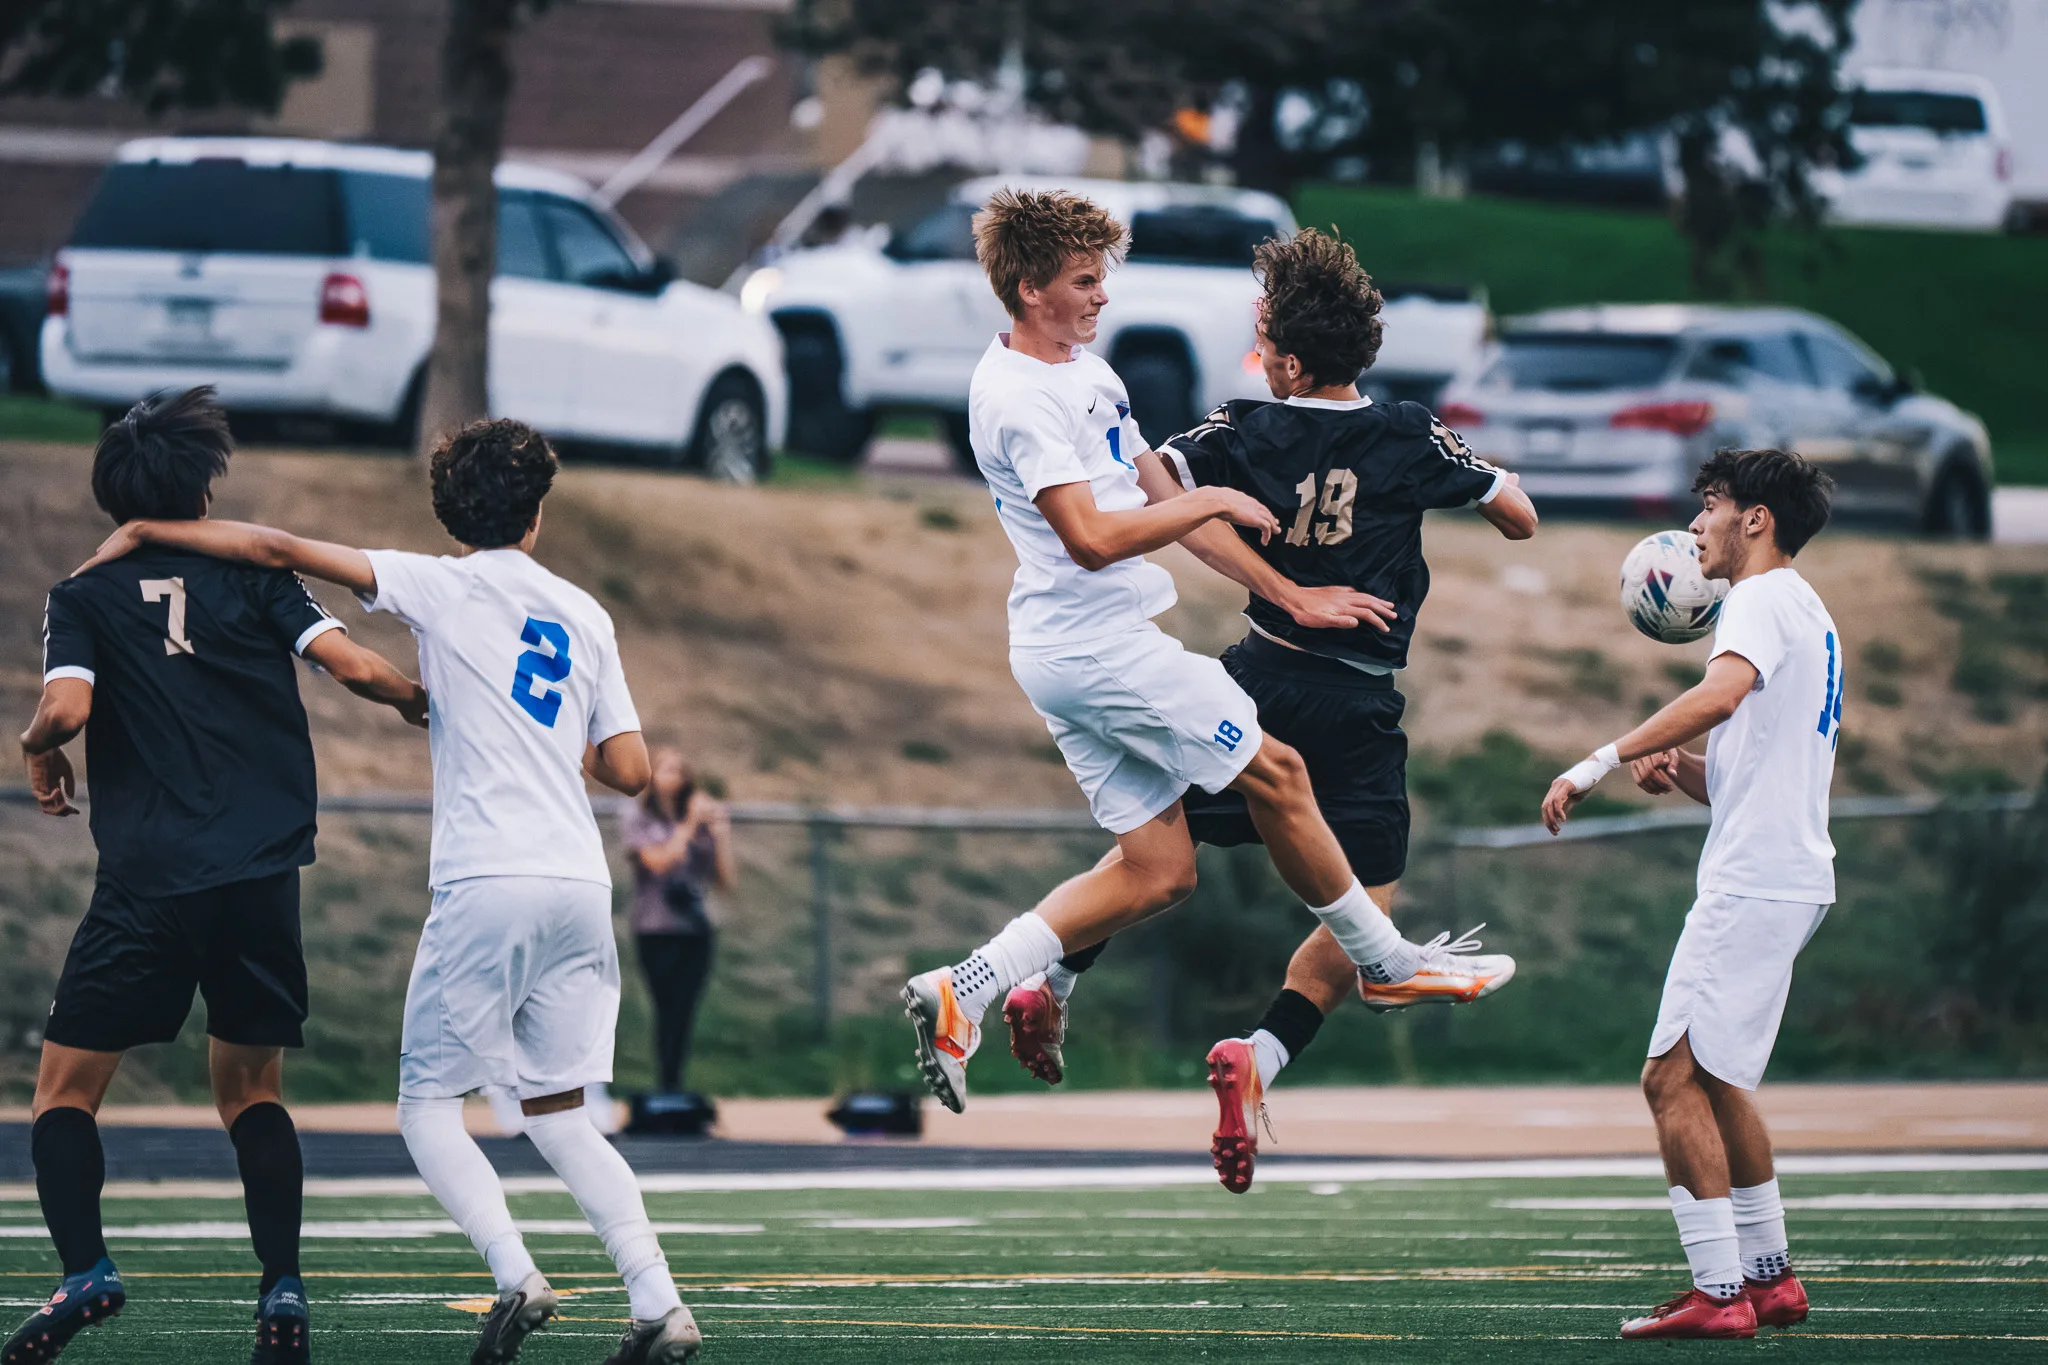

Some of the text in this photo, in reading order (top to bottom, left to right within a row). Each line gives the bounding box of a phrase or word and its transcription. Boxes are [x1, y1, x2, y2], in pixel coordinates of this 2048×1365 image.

[1285, 468, 1358, 546] 19
[140, 576, 195, 656] 7
[511, 616, 572, 728] 2
[1214, 720, 1243, 752] 18
